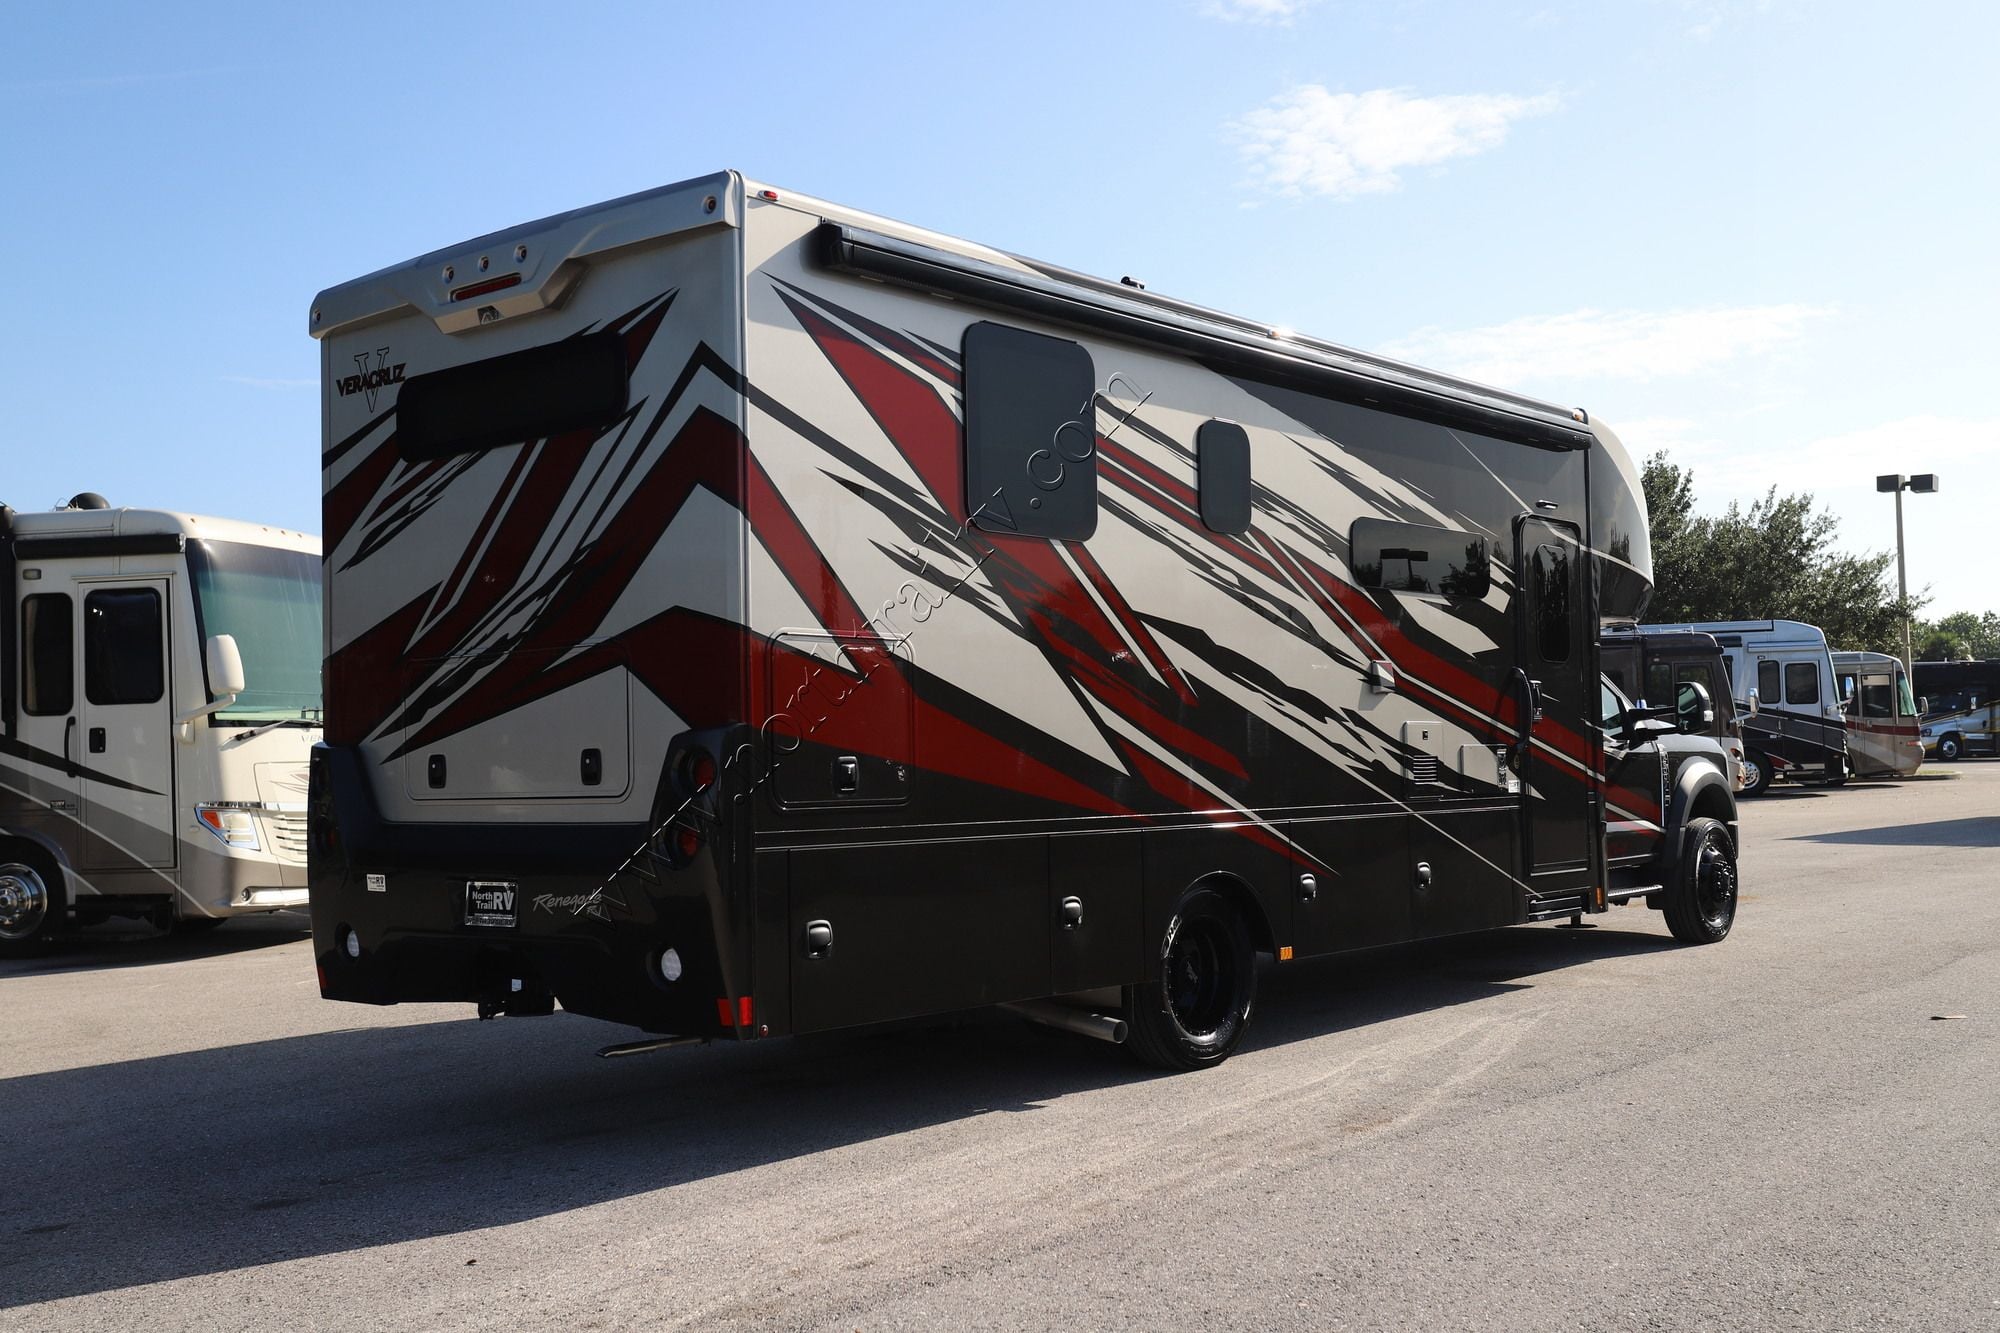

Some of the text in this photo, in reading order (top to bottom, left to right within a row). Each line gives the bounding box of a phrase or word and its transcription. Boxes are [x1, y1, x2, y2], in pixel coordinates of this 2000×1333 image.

[335, 362, 407, 398] VERACRUZ
[472, 890, 493, 900] North
[475, 900, 493, 910] Trail
[493, 890, 515, 910] RV
[532, 888, 602, 915] Renegade
